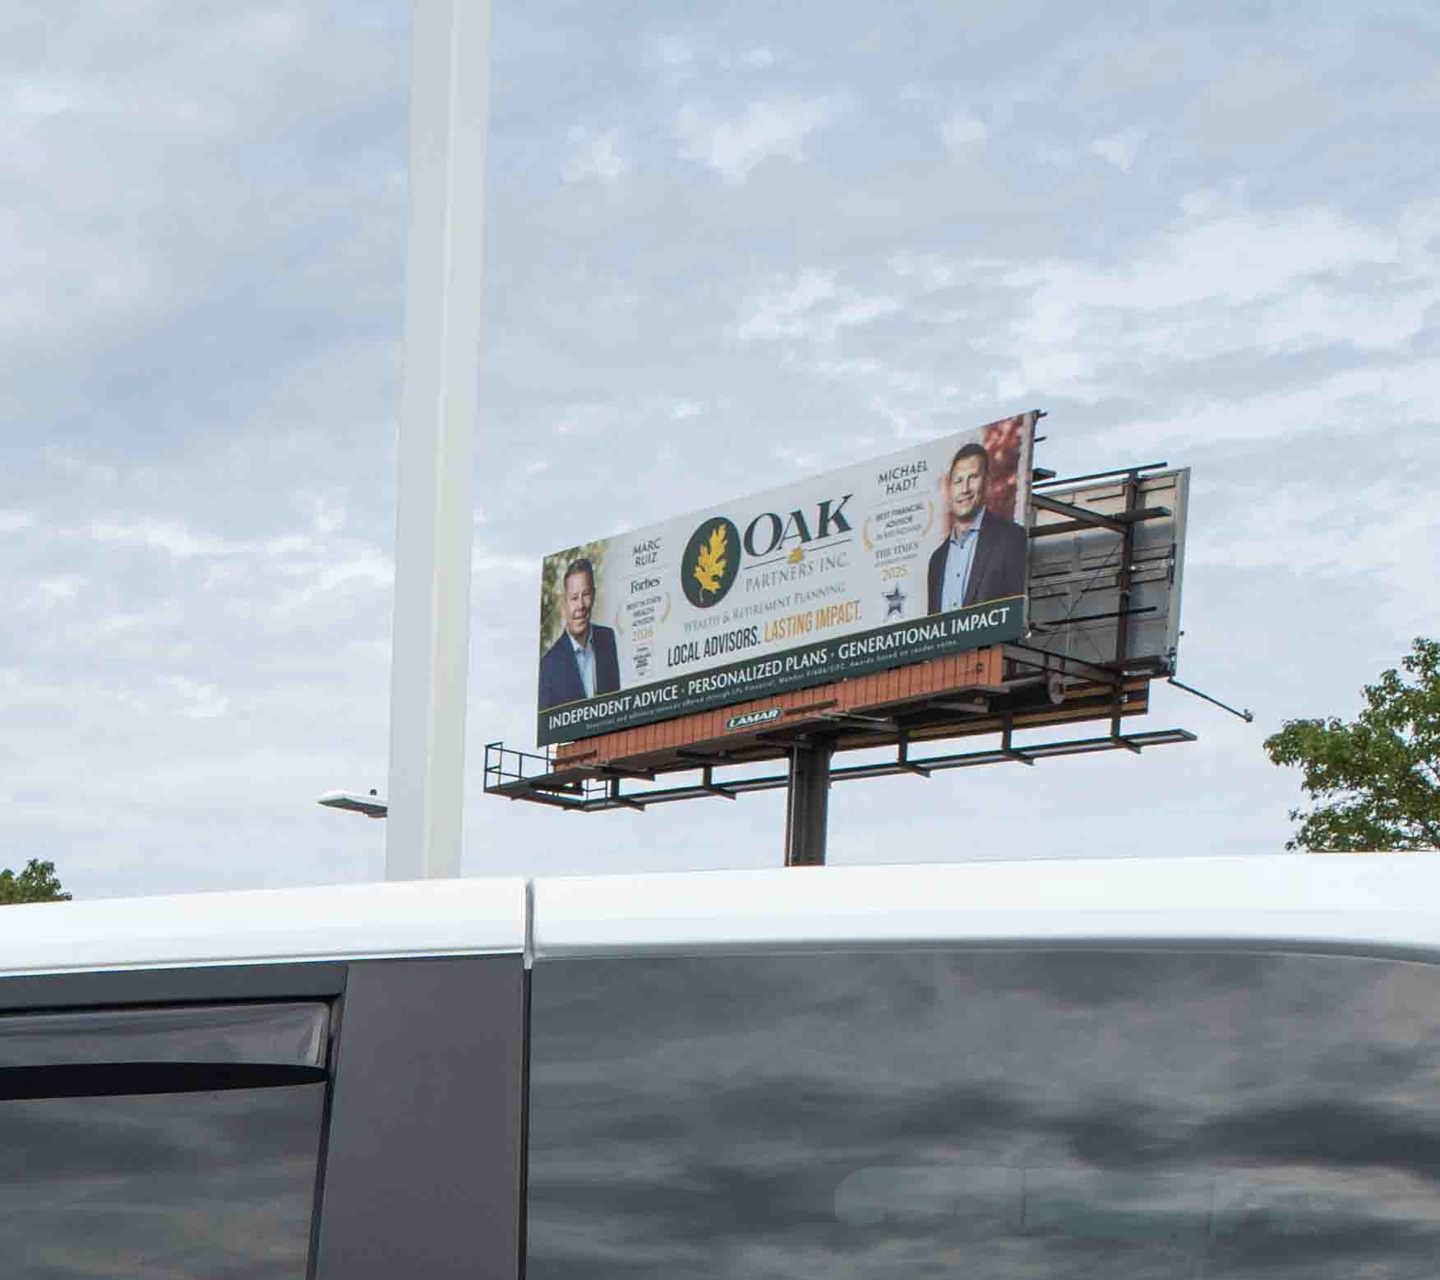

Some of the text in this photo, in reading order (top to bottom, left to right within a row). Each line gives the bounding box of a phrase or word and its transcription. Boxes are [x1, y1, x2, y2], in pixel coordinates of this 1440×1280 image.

[878, 460, 928, 484] MICHAEL
[886, 476, 919, 496] HADT
[743, 493, 854, 557] OAK
[633, 537, 661, 556] MARC
[635, 552, 657, 567] RUIZ
[630, 578, 660, 594] Forbes
[745, 561, 814, 592] PARTNERS
[668, 639, 701, 667] LOCAL
[703, 626, 761, 659] ADVISORS.
[764, 608, 813, 642] LASTING
[815, 599, 862, 629] IMPACT.
[548, 696, 632, 731] INDEPENDENT
[632, 685, 679, 709] ADVICE
[687, 660, 783, 696] PERSONALIZED
[785, 649, 828, 672] PLANS
[838, 624, 948, 660] GENERATIONAL
[951, 607, 1010, 634] IMPACT
[729, 709, 779, 728] LAMAR
